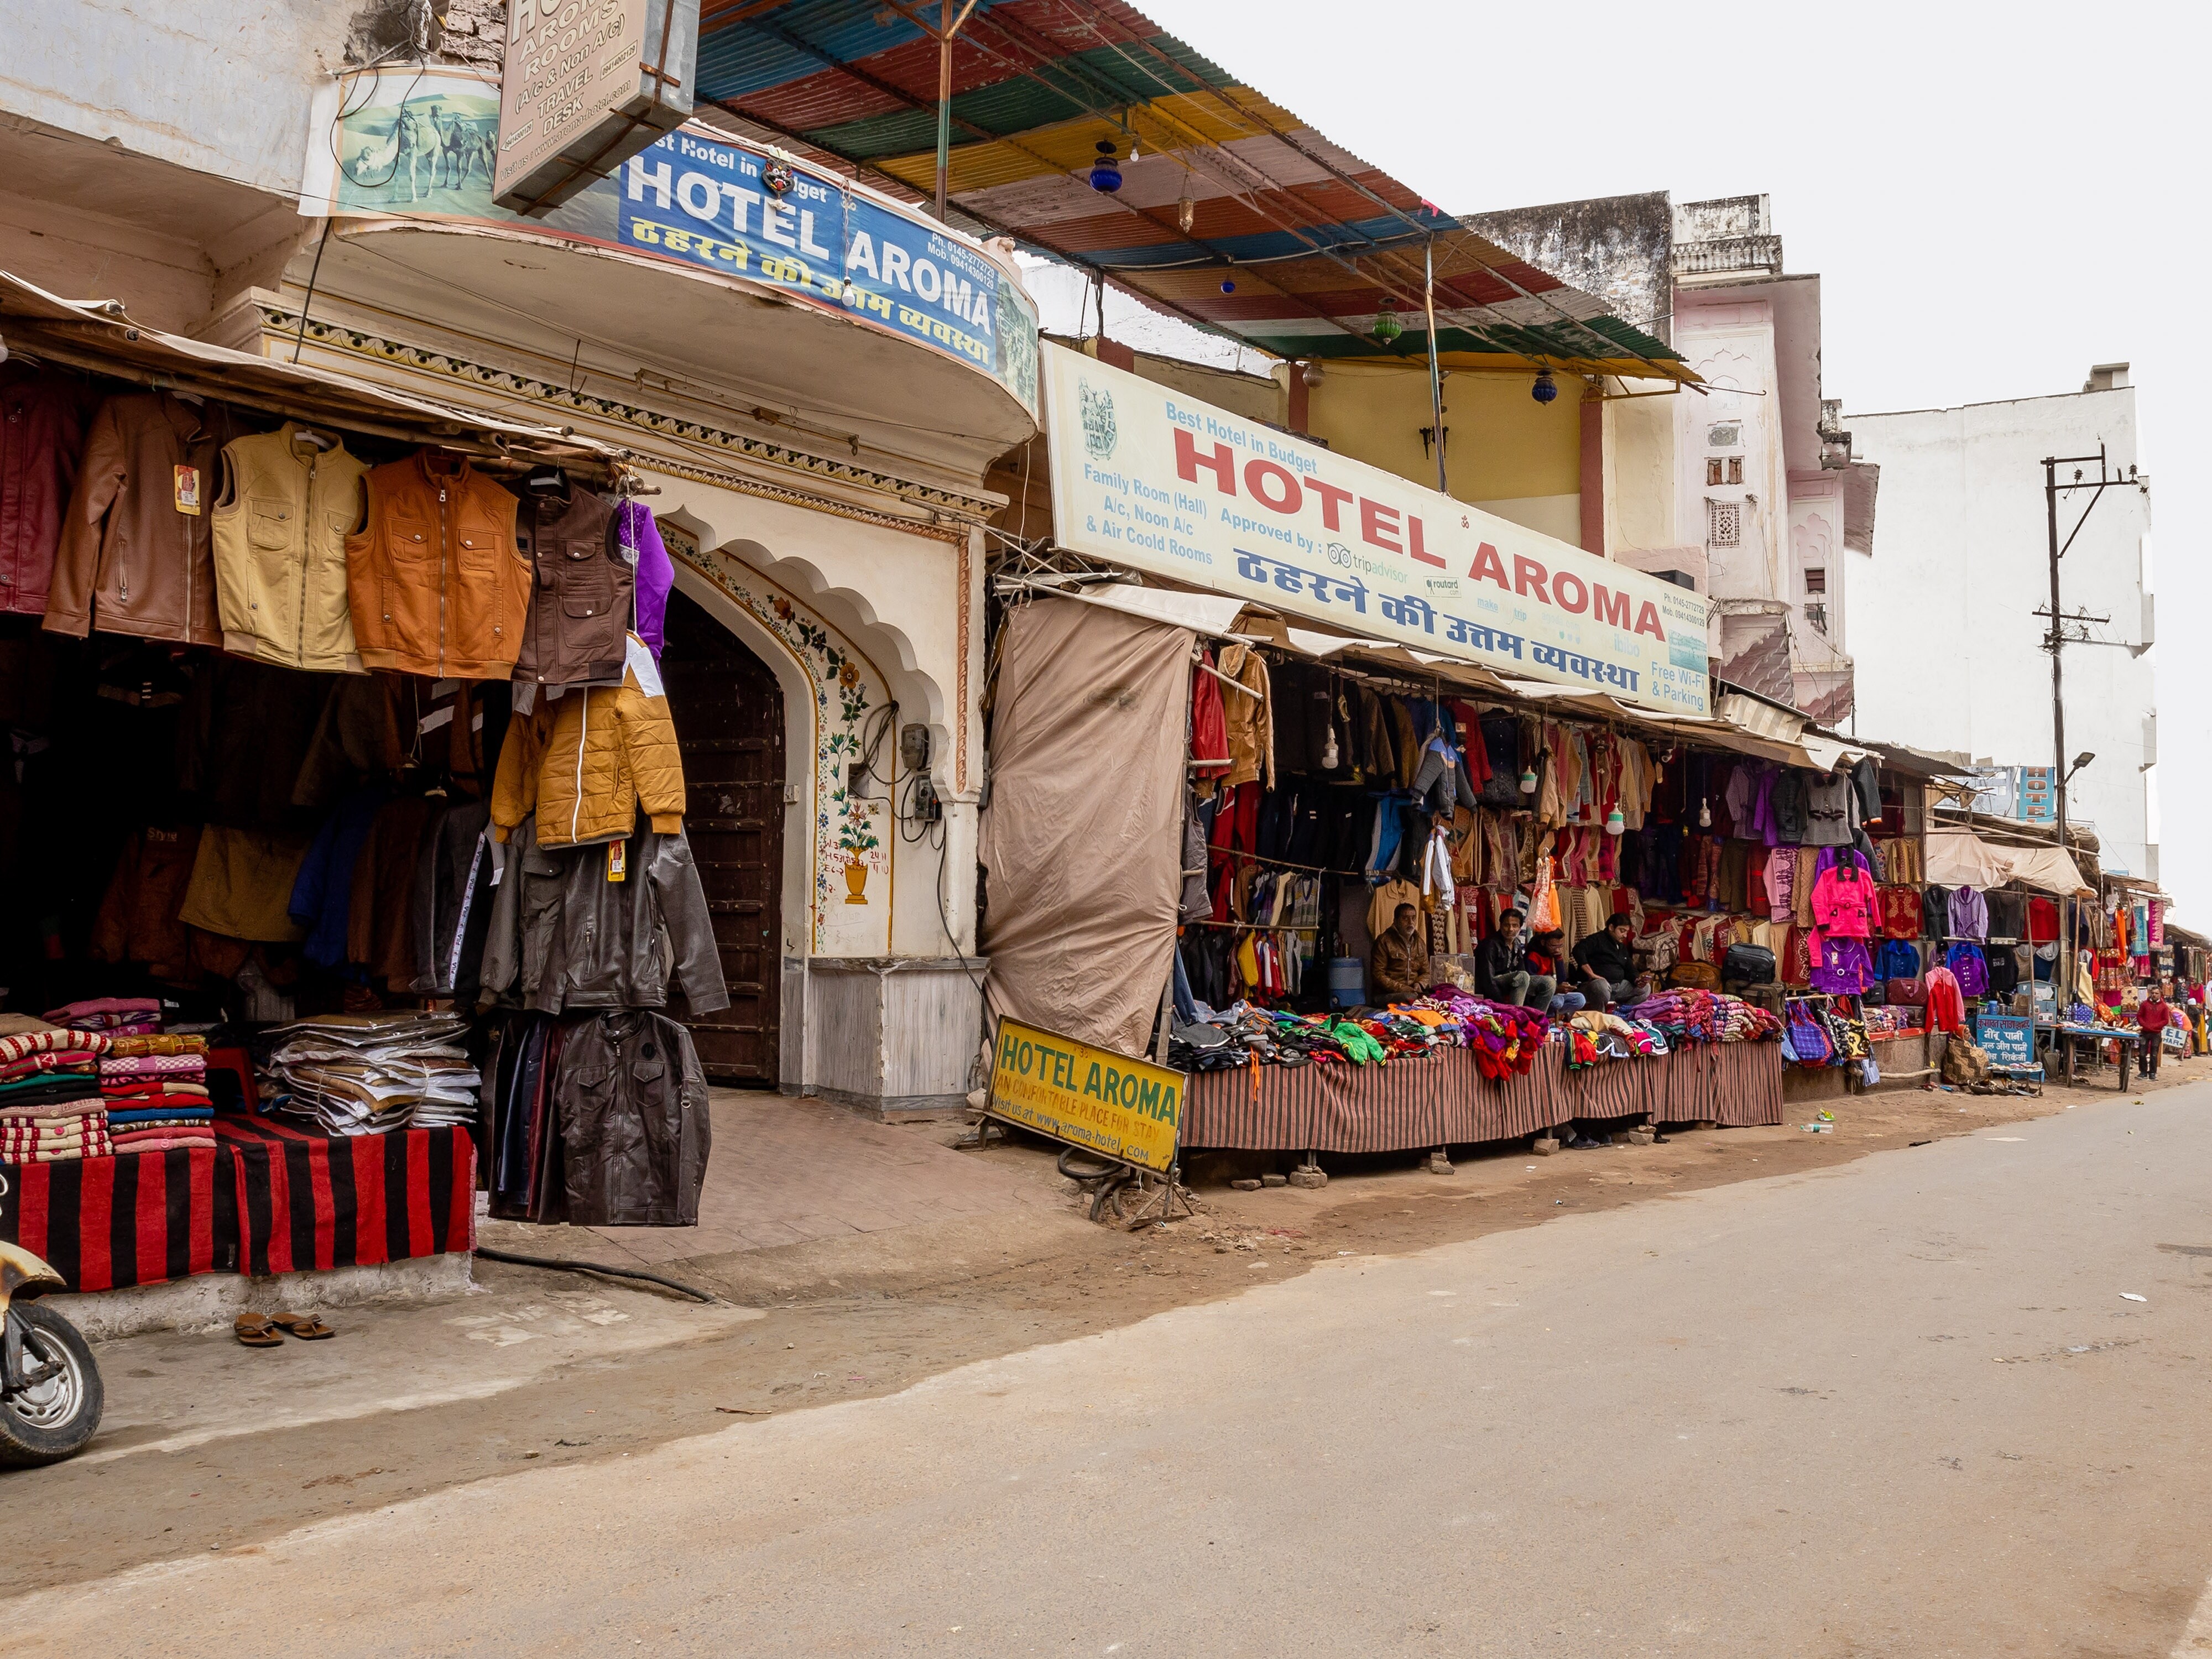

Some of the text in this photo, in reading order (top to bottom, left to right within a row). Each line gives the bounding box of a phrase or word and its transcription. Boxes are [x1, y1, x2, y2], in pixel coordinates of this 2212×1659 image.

[515, 13, 625, 114] (A/c & Non A/c)
[524, 0, 618, 83] ROOMS
[538, 67, 593, 118] TRAVEL
[542, 92, 584, 137] DESK
[500, 160, 517, 181] Visit
[518, 155, 528, 170] us
[535, 80, 631, 157] www.aroma-hotel.com
[681, 137, 734, 170] Hotel
[740, 156, 757, 178] in
[627, 155, 829, 260] HOTEL
[928, 242, 994, 290] Mob. 09414300129
[932, 232, 994, 278] Ph. 0145-2772729
[630, 216, 753, 270] ठहरने
[760, 253, 815, 289] की
[899, 304, 989, 364] व्यवस्था
[848, 230, 992, 336] AROMA
[1166, 401, 1317, 475] Best Hotel in Budget
[1084, 463, 1207, 520] Family Room (Hall)
[1104, 495, 1194, 536] A/c, Noon A/c
[1086, 515, 1213, 565] & Air Coold Rooms
[1173, 427, 1666, 643] HOTEL AROMA
[1220, 507, 1293, 545] Approved
[1297, 528, 1314, 553] by
[1353, 554, 1408, 583] tripadvisor
[1433, 580, 1458, 589] routard
[1233, 547, 1640, 692] ठहरने की उत्तम व्यवस्था
[1477, 597, 1498, 611] make
[1514, 608, 1526, 622] trip
[1662, 605, 1704, 627] Mob. 09414300129
[1673, 596, 1704, 614] 0145-2772729
[1651, 661, 1704, 690] Free Wi-Fi
[1652, 681, 1703, 711] & Parking
[2025, 767, 2048, 823] HOTE
[1001, 1034, 1176, 1126] HOTEL AROMA
[1023, 1108, 1034, 1120] at
[1079, 1102, 1109, 1127] PLACE
[1111, 1113, 1129, 1134] FOR
